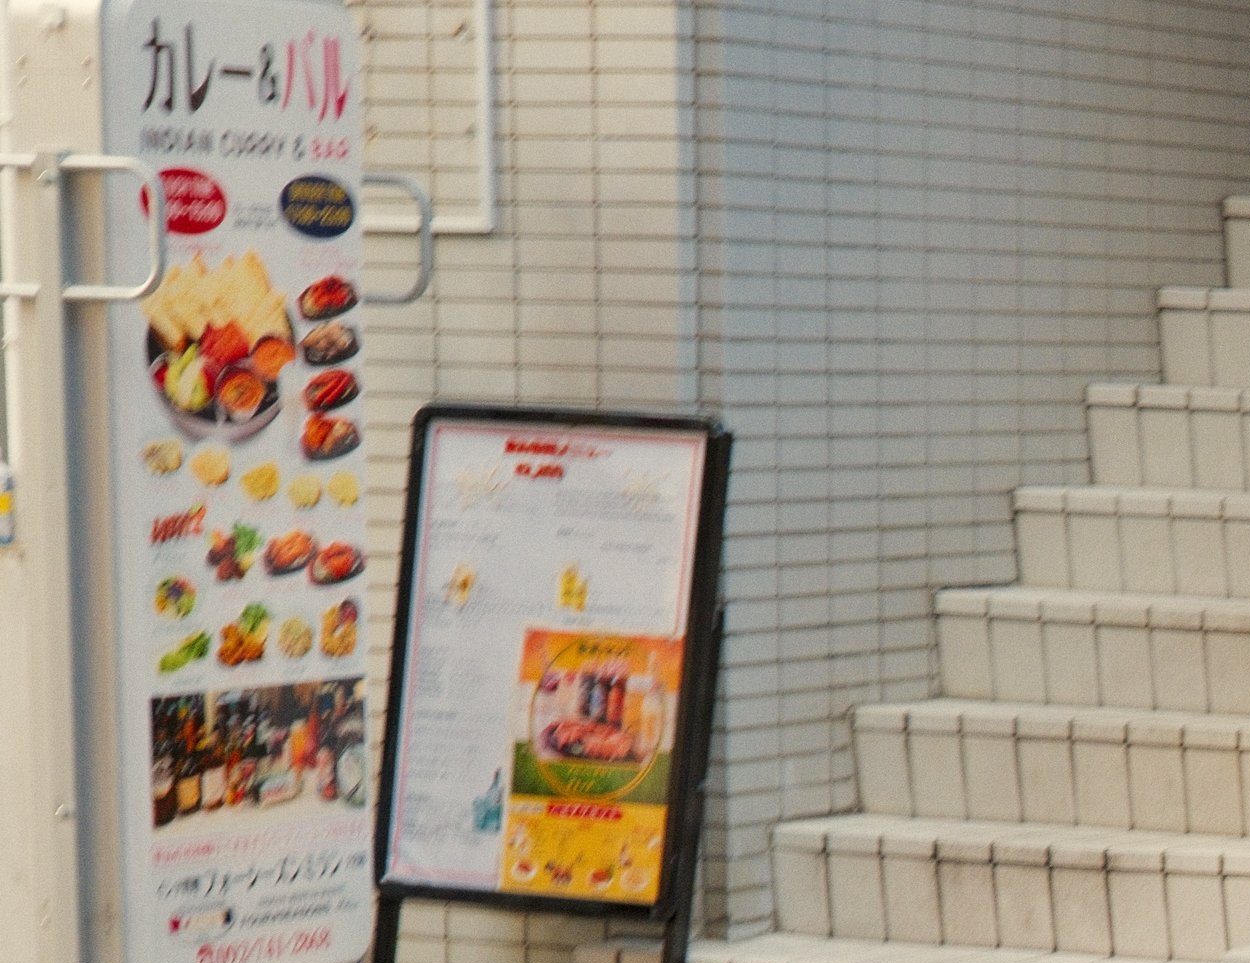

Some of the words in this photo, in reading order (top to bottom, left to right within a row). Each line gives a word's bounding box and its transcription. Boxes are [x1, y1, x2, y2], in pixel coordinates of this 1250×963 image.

[140, 126, 214, 155] INDIAN
[219, 129, 286, 158] CURRY
[310, 136, 350, 161] BAR
